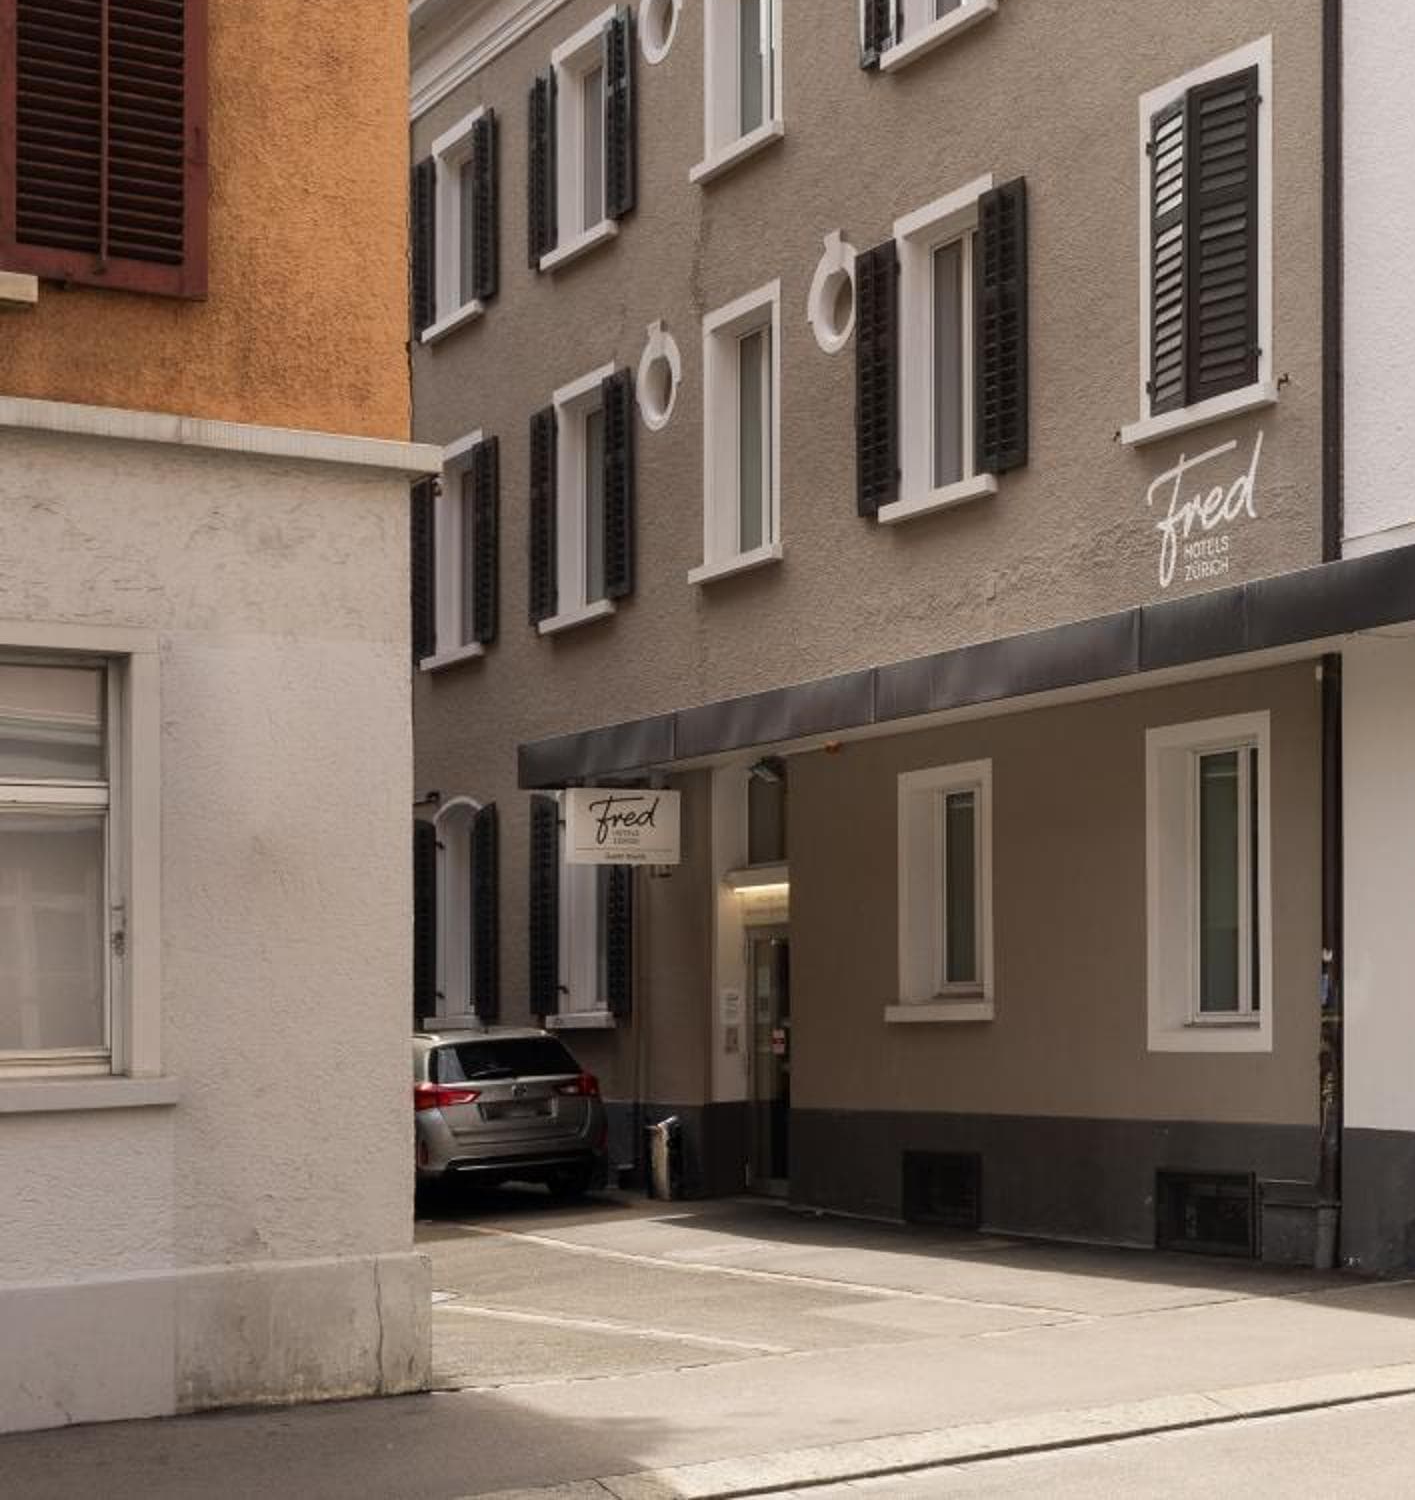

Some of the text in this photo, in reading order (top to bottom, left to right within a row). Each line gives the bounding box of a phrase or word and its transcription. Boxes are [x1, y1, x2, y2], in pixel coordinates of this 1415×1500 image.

[1147, 429, 1264, 588] Fred
[1183, 535, 1230, 558] HOTELS
[1184, 556, 1230, 581] ZÜRICH
[588, 795, 660, 845] Fred
